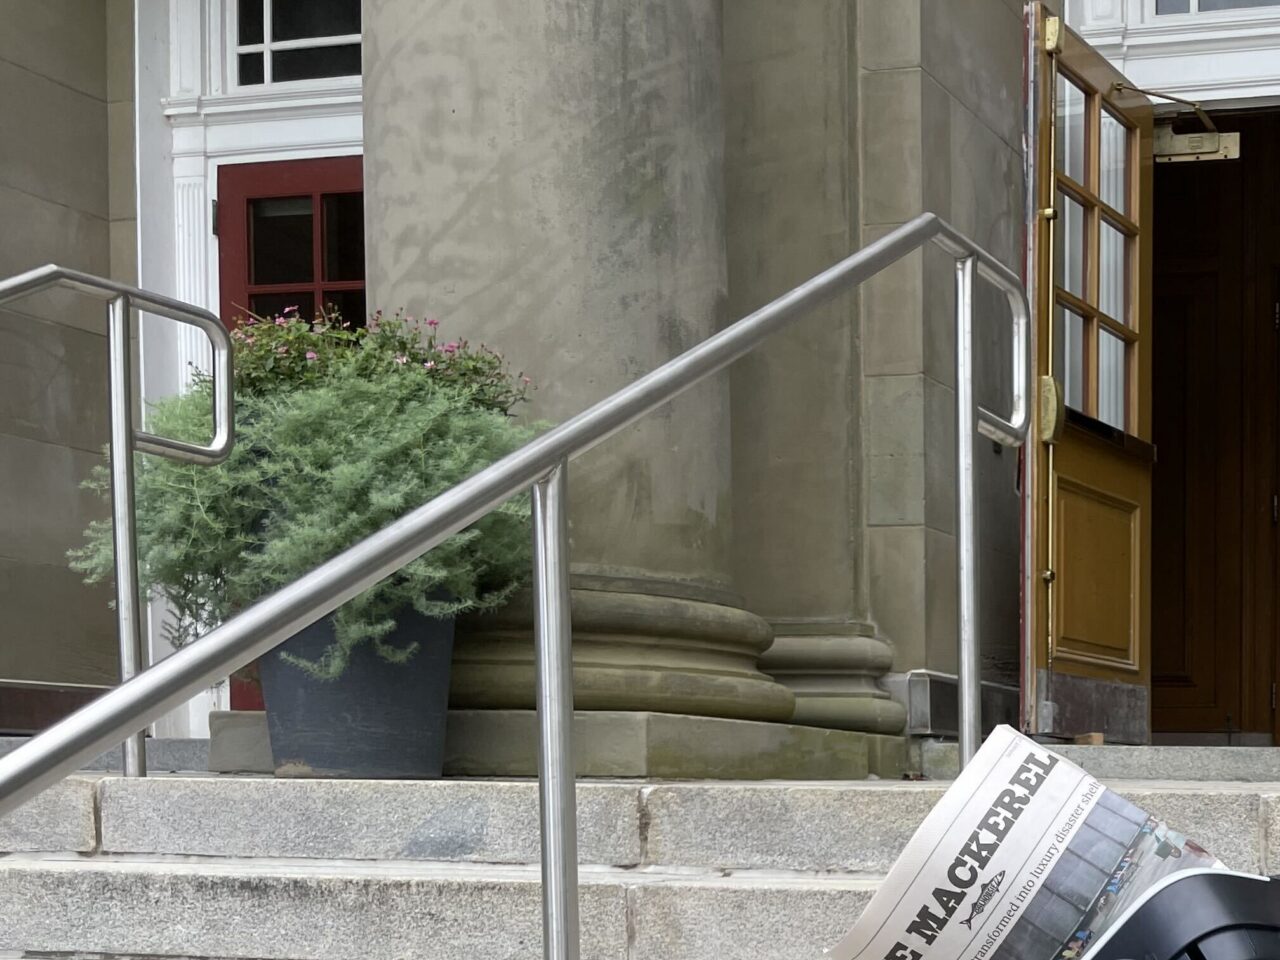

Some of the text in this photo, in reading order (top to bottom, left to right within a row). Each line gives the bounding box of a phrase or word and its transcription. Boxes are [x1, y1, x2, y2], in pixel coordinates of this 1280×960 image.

[905, 752, 1060, 946] MACKEREL
[1018, 878, 1036, 905] into
[1029, 842, 1060, 881] luxury
[1055, 804, 1085, 844] disaster
